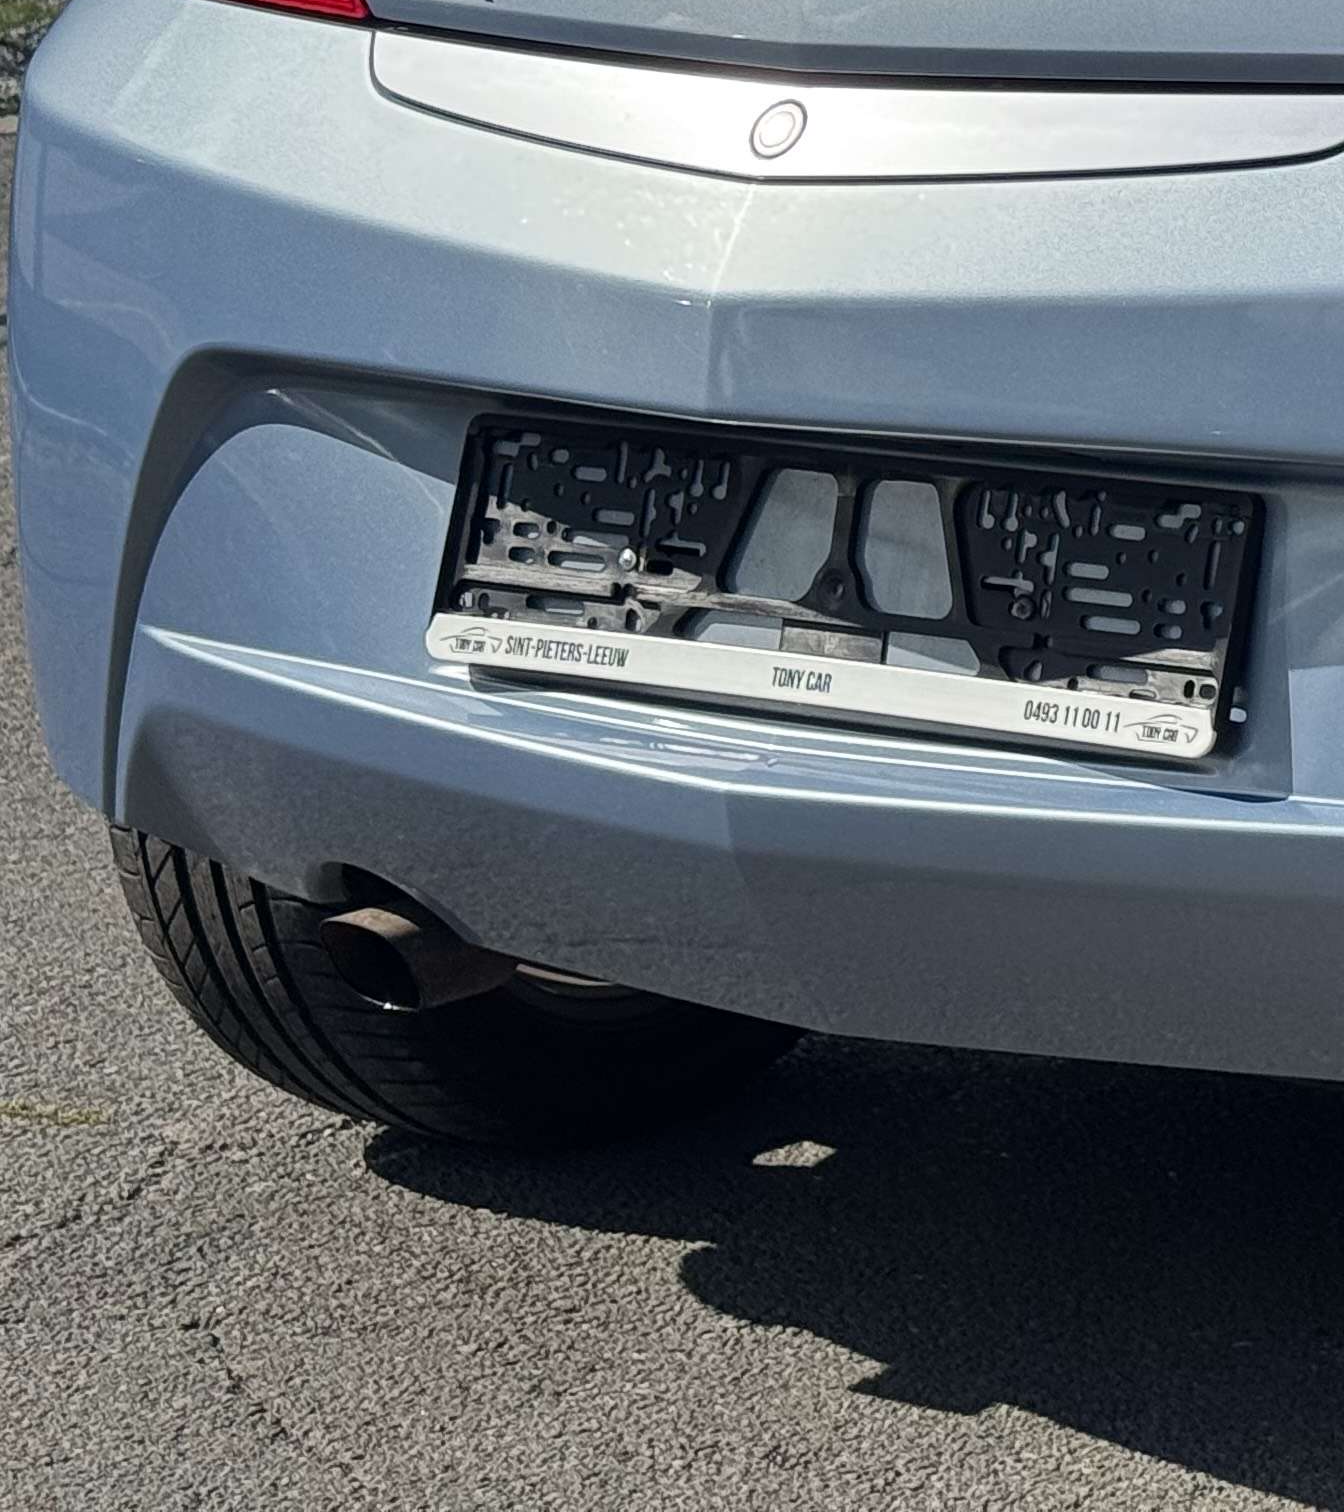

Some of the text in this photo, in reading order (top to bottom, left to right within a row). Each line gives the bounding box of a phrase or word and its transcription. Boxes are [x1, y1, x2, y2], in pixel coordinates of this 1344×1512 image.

[504, 634, 630, 668] SINT-PIETERS-LEEUW
[771, 666, 833, 694] TONY CAR
[1024, 699, 1121, 733] 0493 11 00 11
